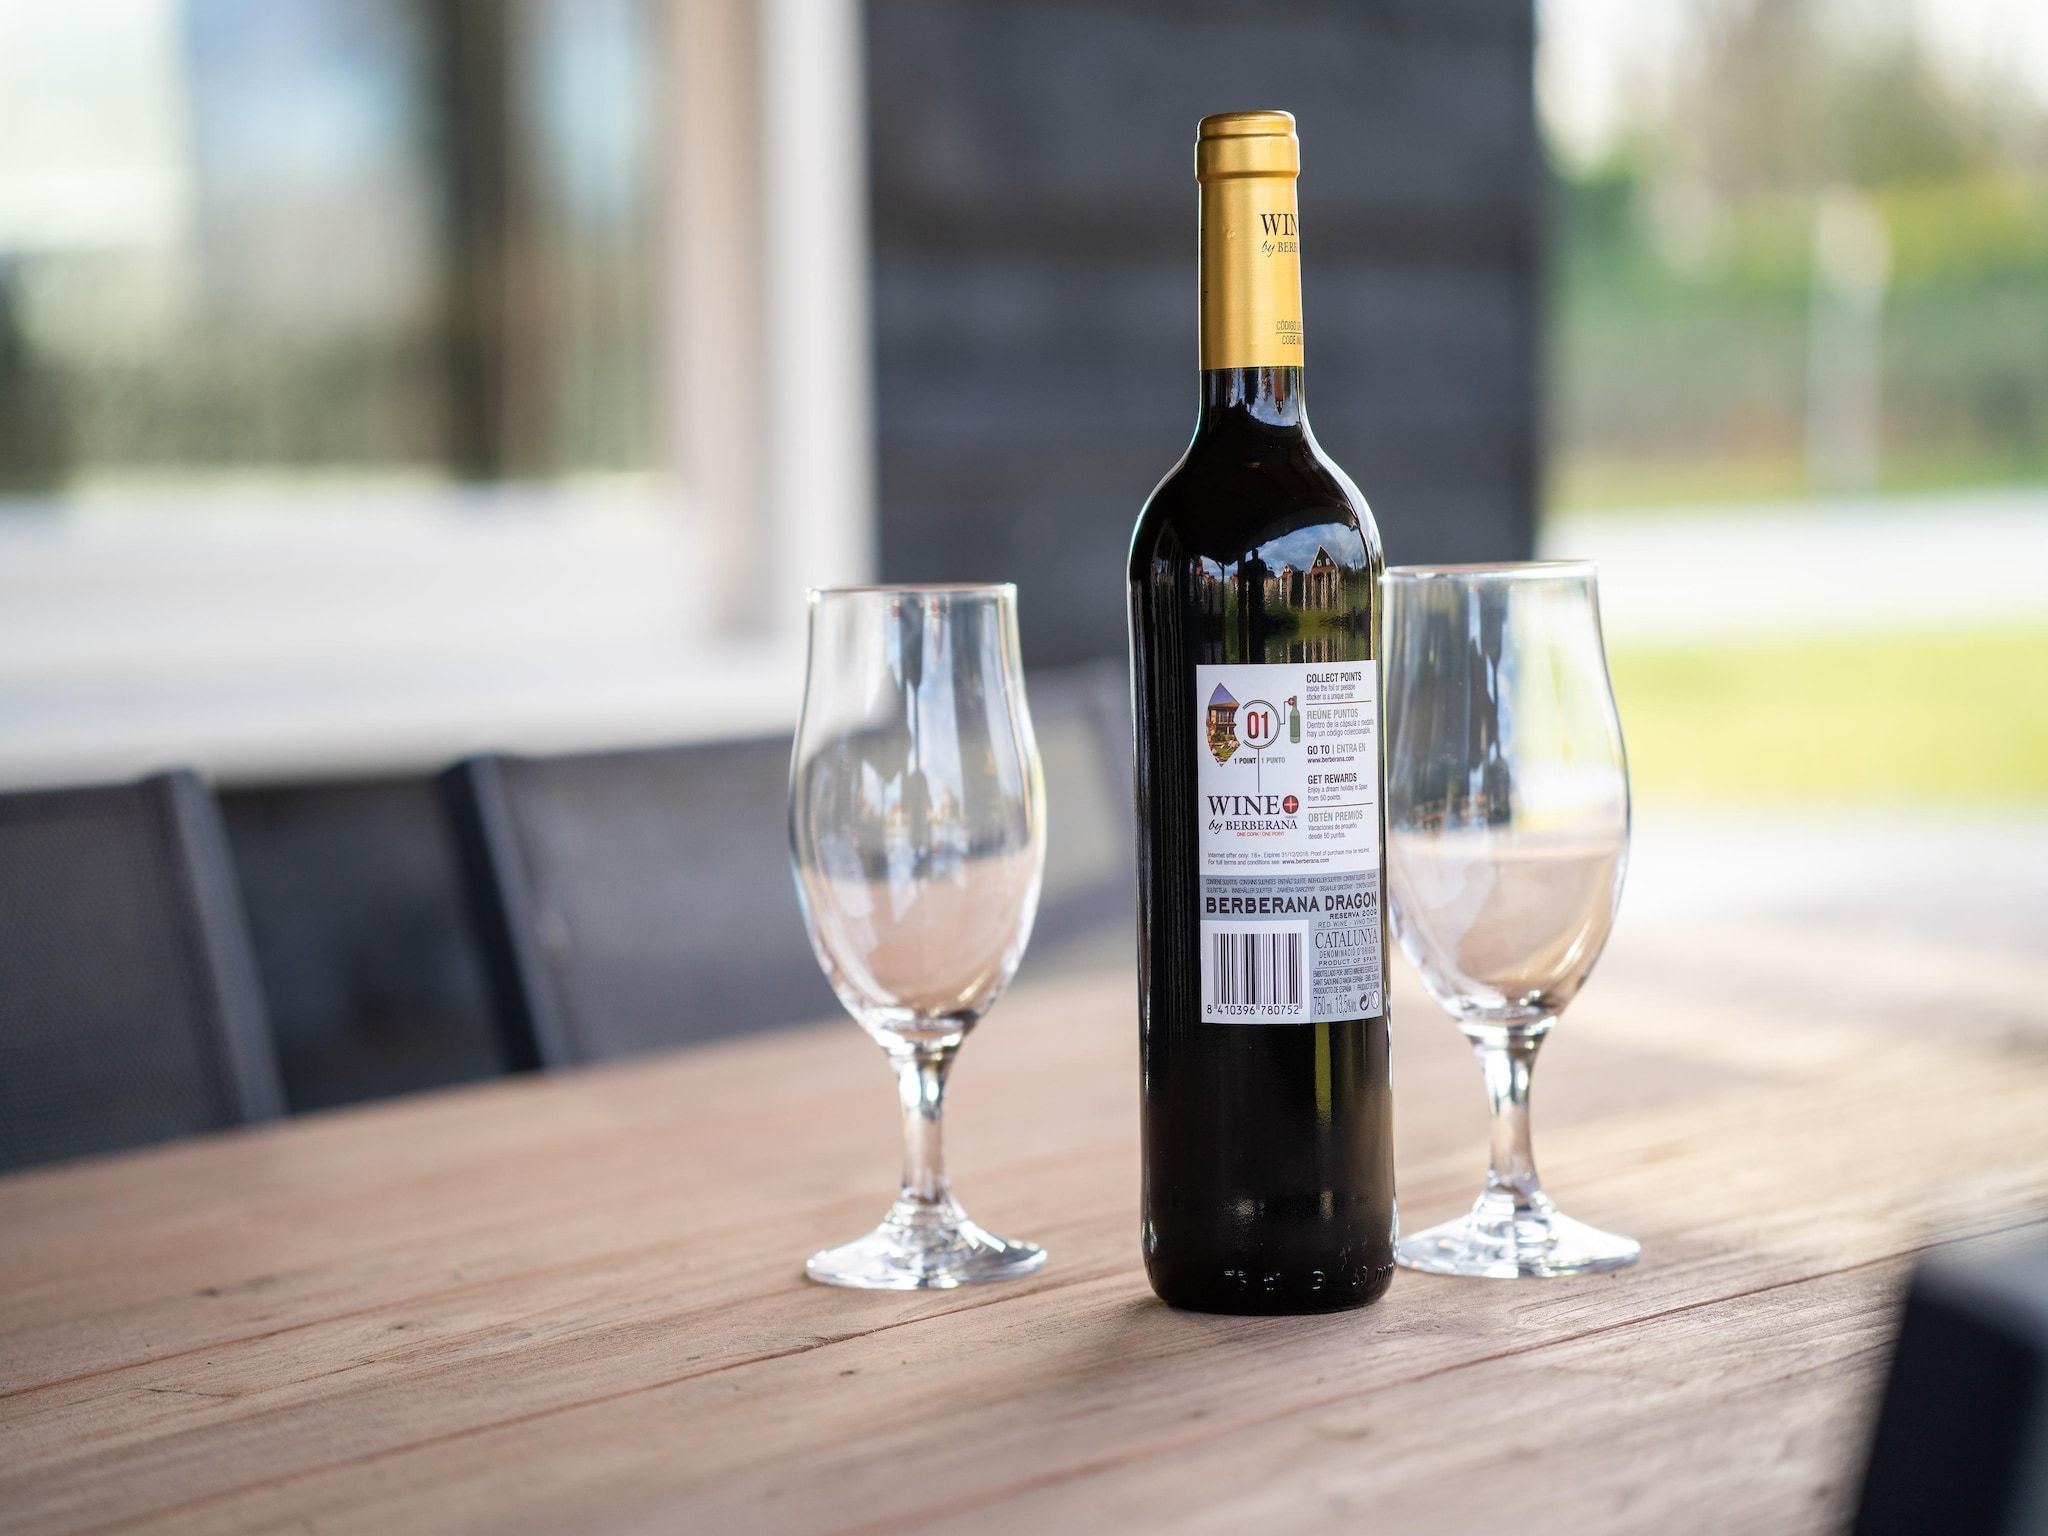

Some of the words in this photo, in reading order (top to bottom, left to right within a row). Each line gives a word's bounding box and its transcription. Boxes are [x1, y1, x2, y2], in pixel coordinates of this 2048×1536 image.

[1261, 240, 1275, 258] by
[1306, 672, 1339, 683] COLLECT
[1340, 671, 1362, 681] POINTS
[1306, 708, 1332, 720] REÚNE
[1333, 708, 1359, 719] PUNTOS
[1247, 711, 1268, 739] 01
[1306, 720, 1325, 729] Dentro
[1326, 720, 1334, 728] de
[1334, 720, 1339, 728] la
[1306, 729, 1317, 739] hay
[1318, 729, 1326, 737] un
[1307, 745, 1319, 755] GO
[1320, 744, 1330, 755] TO
[1336, 743, 1358, 754] ENTRA
[1358, 742, 1366, 752] EN
[1238, 757, 1257, 765] POINT
[1307, 756, 1355, 764] www.berberana.com
[1307, 774, 1323, 785] GET
[1324, 772, 1358, 784] REWARDS
[1307, 785, 1321, 795] Enjoy
[1325, 785, 1340, 793] dream
[1207, 795, 1281, 817] WINE
[1308, 811, 1333, 823] OBTÉN
[1334, 809, 1364, 821] PREMIOS
[1208, 819, 1223, 835] by
[1225, 819, 1298, 831] BERBERANA
[1334, 822, 1341, 830] de
[1323, 831, 1330, 839] 50
[1282, 857, 1330, 865] www.berberana.com
[1206, 896, 1320, 914] BERBERANA
[1325, 891, 1377, 912] DRAGON
[1329, 911, 1360, 920] RESERVA
[1317, 921, 1331, 929] RED
[1332, 919, 1348, 927] WINE
[1315, 927, 1378, 950] CATALUNYA
[1319, 946, 1356, 959] DENOMINACIÓ
[1318, 958, 1351, 966] PRODUCT
[1206, 1004, 1213, 1015] 8
[1217, 1004, 1256, 1016] 410396
[1261, 1004, 1300, 1016] 780752
[1313, 996, 1326, 1015] 750
